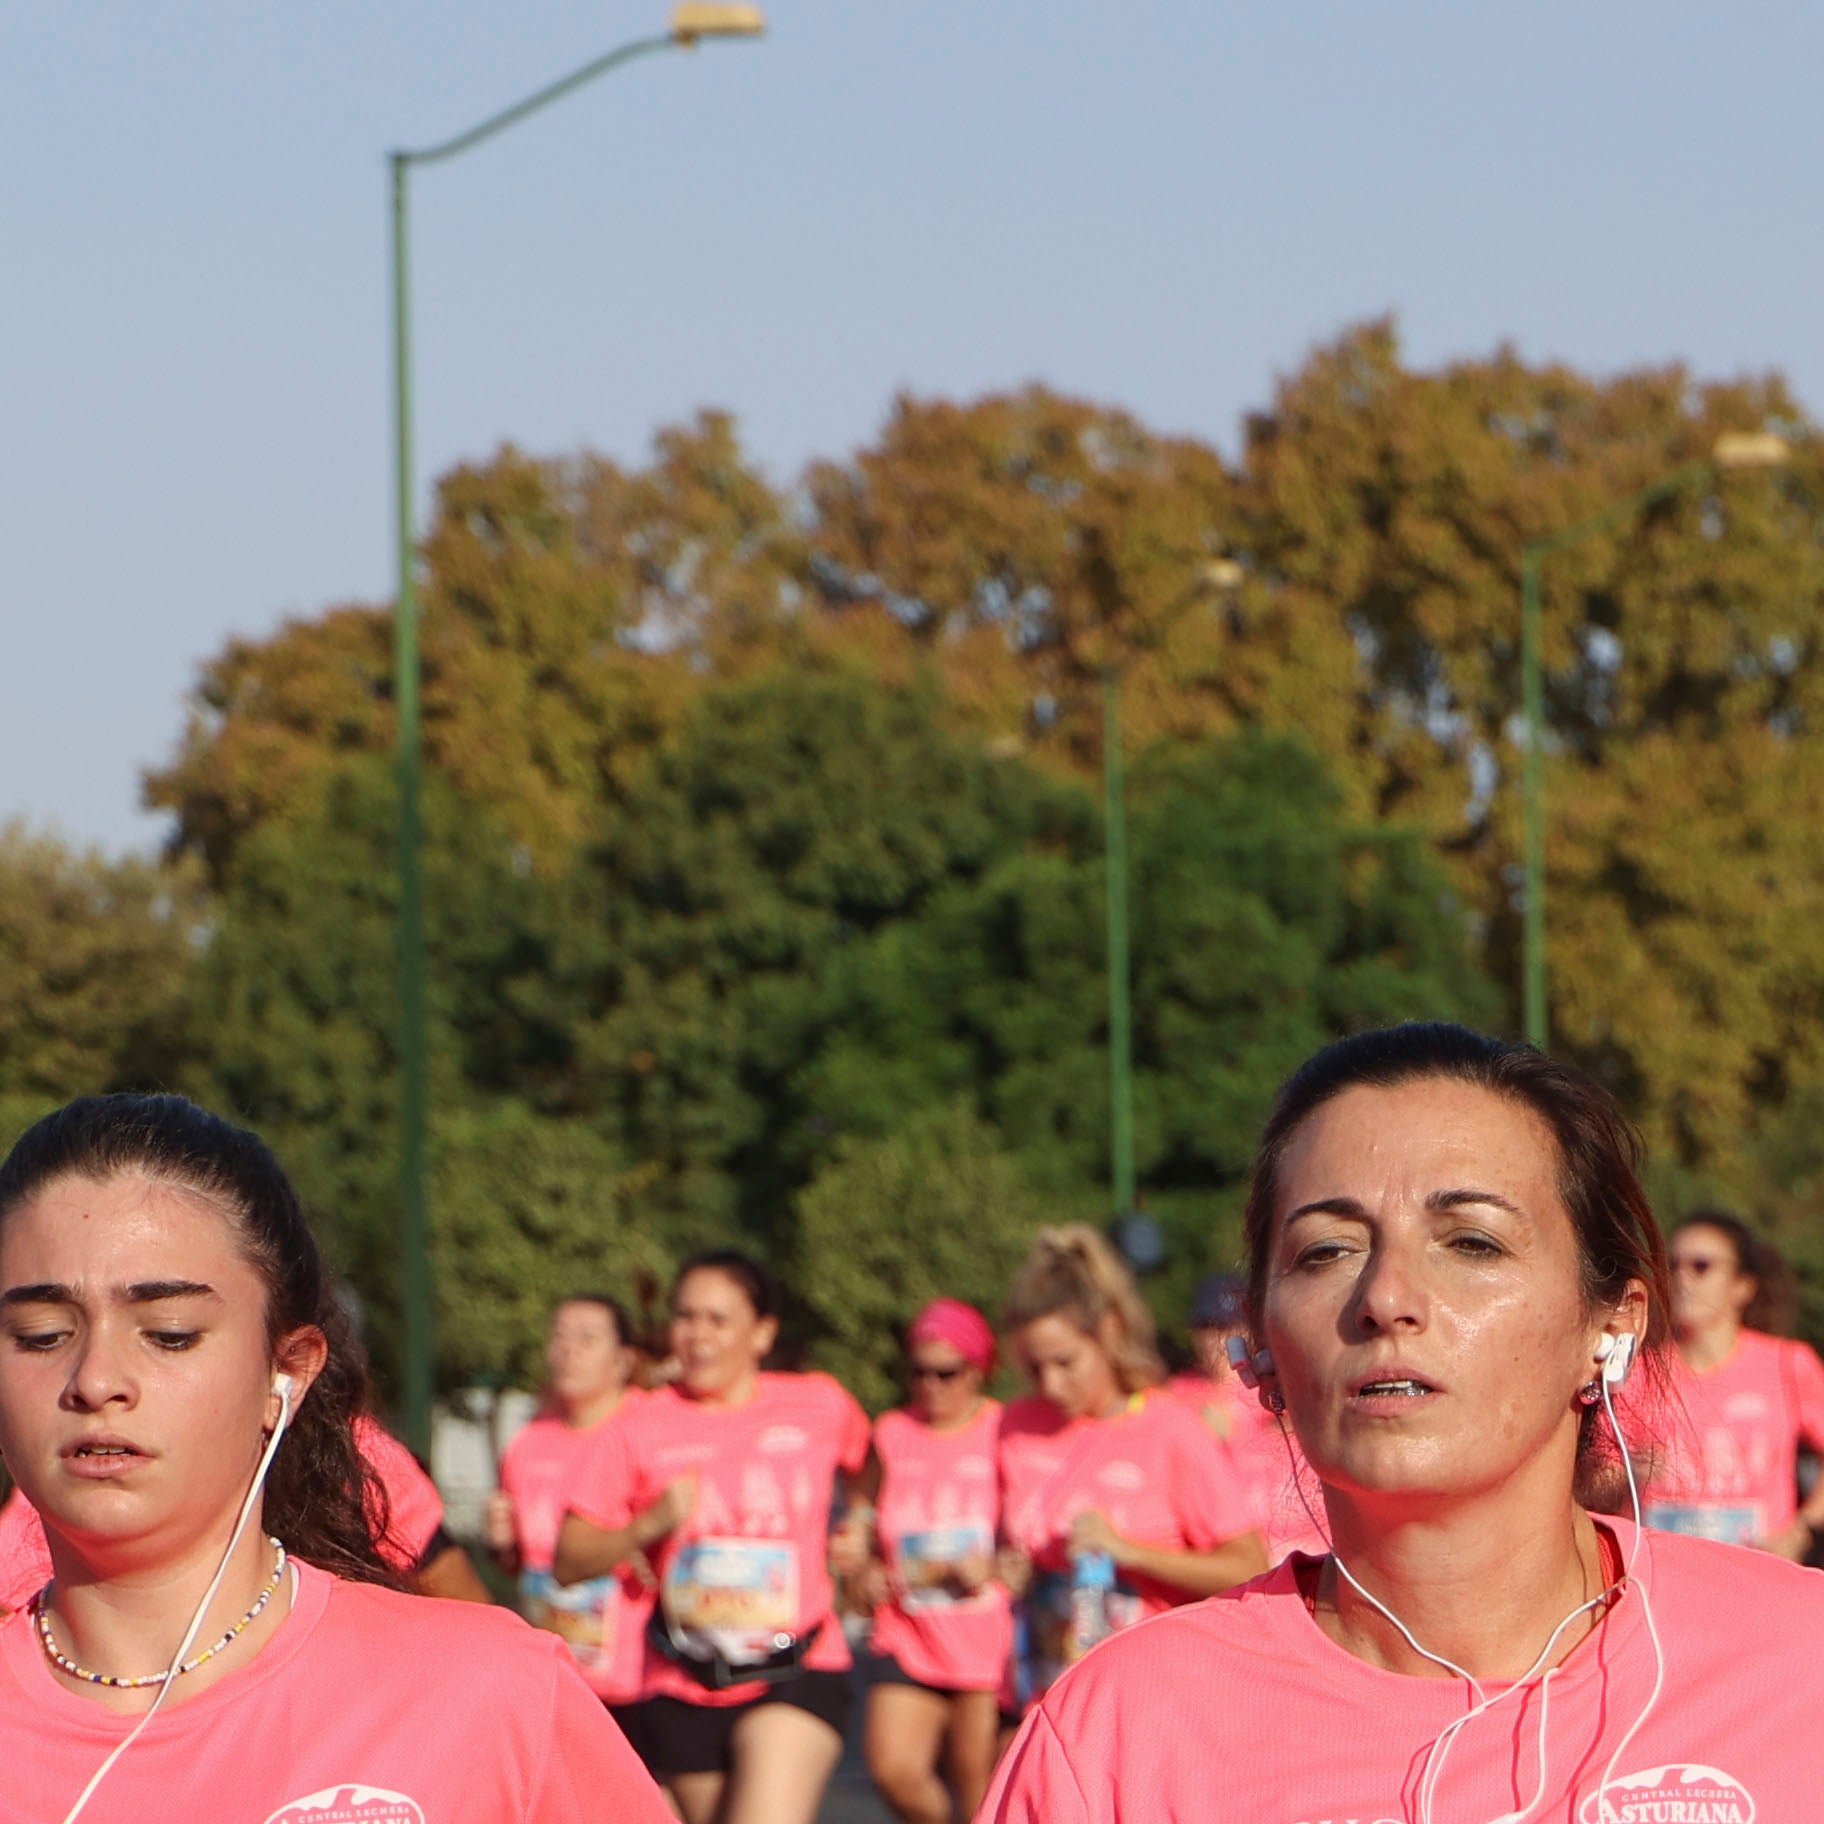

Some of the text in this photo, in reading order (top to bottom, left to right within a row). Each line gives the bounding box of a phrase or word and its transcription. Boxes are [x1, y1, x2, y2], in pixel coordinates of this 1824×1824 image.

[1621, 1787, 1736, 1803] CENTRAL LECHERA
[298, 1804, 409, 1824] CENTRAL LECHERA
